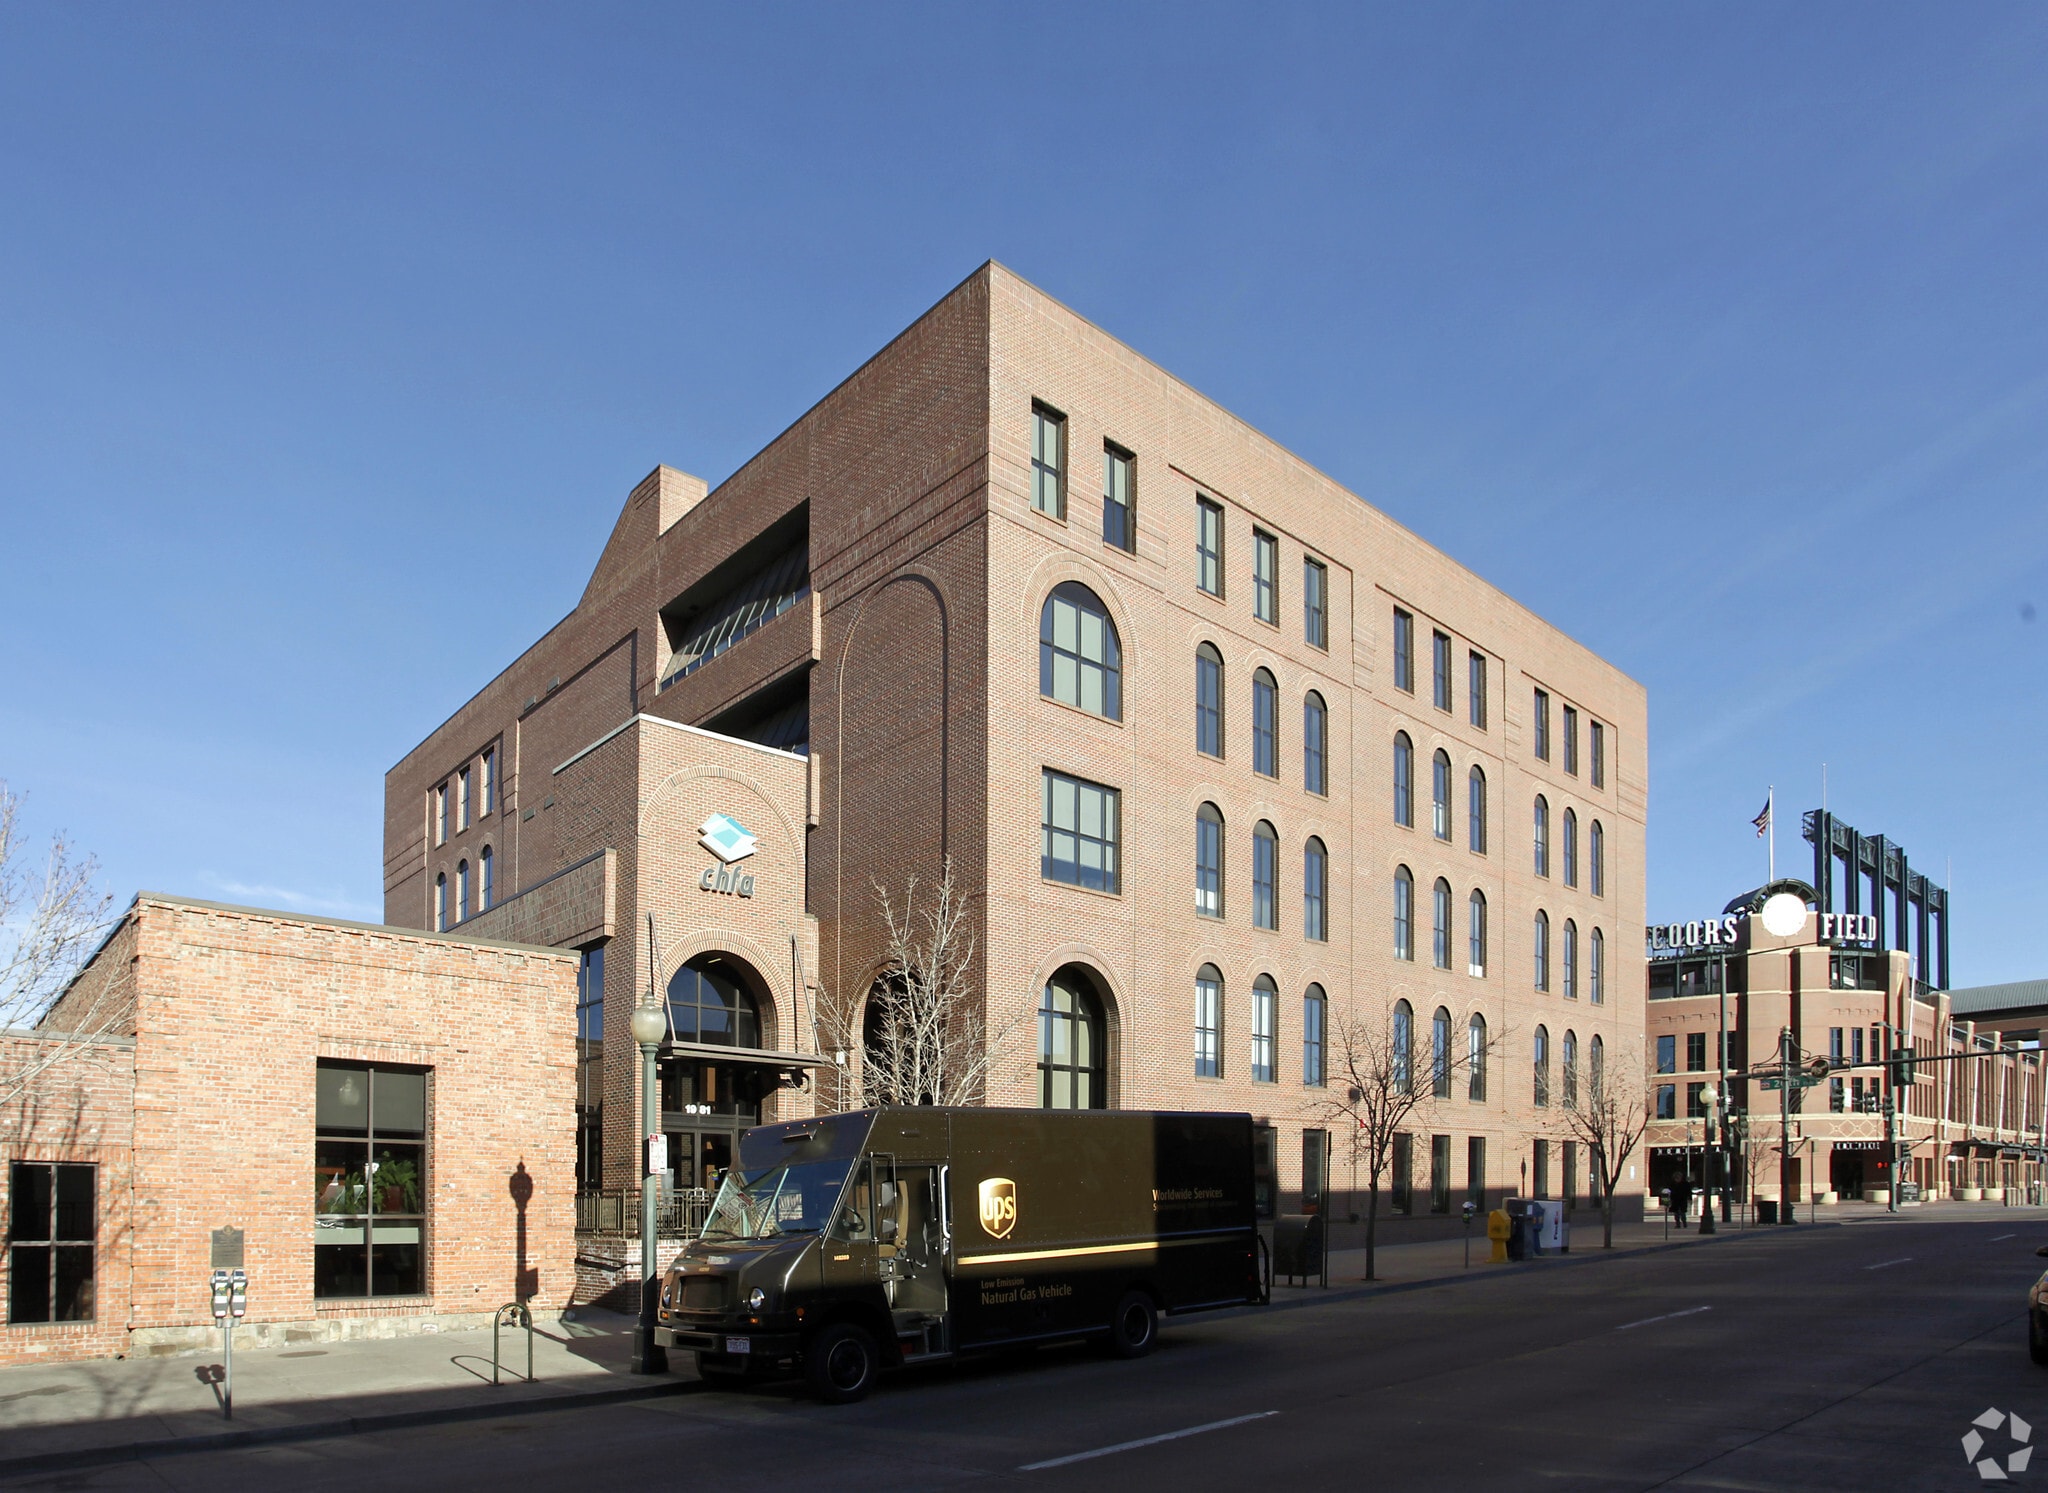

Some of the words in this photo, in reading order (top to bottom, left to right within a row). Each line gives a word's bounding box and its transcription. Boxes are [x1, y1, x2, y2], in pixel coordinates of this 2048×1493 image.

[700, 862, 754, 897] chfa
[1652, 917, 1738, 950] COORS
[1821, 913, 1877, 941] FIELD
[685, 1103, 711, 1115] 1981
[1152, 1187, 1193, 1201] Worldwide
[1194, 1187, 1223, 1200] Services
[982, 1196, 1014, 1230] ups
[981, 1279, 995, 1289] Low
[997, 1277, 1025, 1288] Emission
[981, 1289, 1018, 1305] Natural
[1019, 1287, 1037, 1301] Gas
[1039, 1283, 1073, 1299] Vehicle
